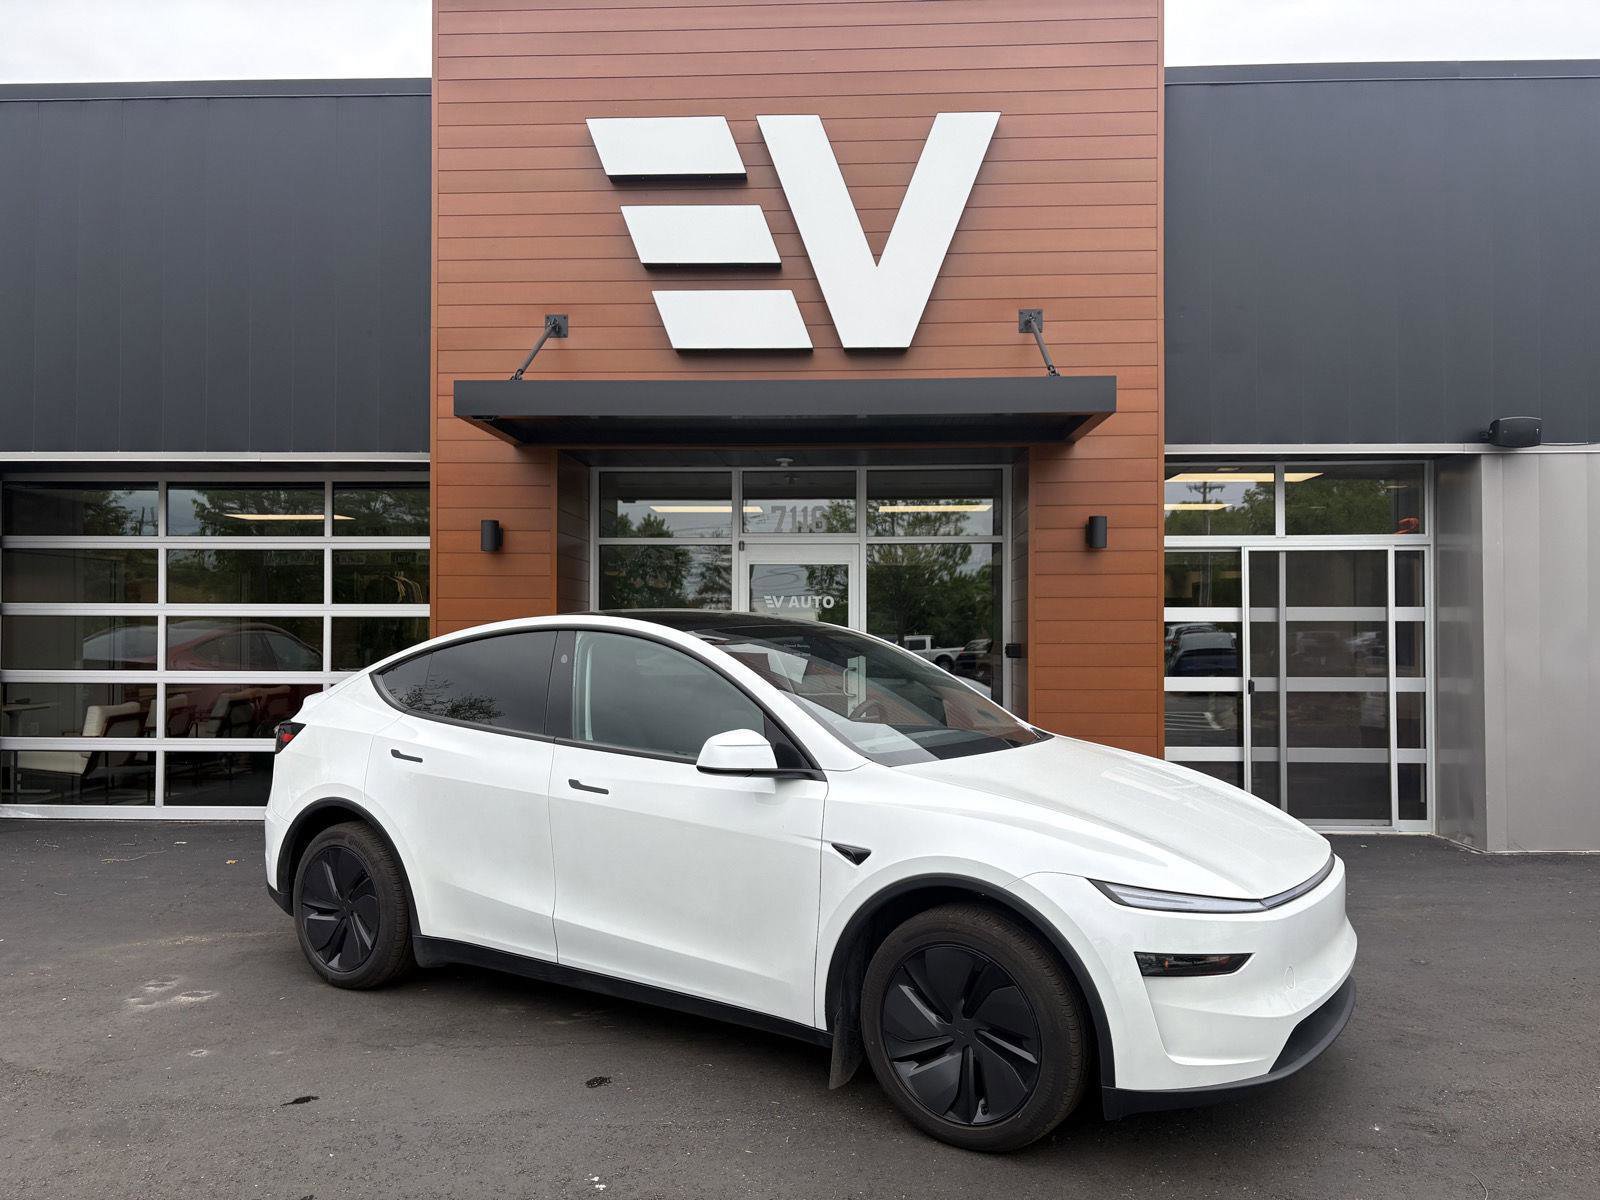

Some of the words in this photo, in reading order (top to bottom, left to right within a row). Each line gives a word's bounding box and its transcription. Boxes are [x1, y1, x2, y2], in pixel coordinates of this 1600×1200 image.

[586, 111, 1001, 352] EV
[763, 595, 785, 609] EV
[788, 595, 835, 609] AUTO
